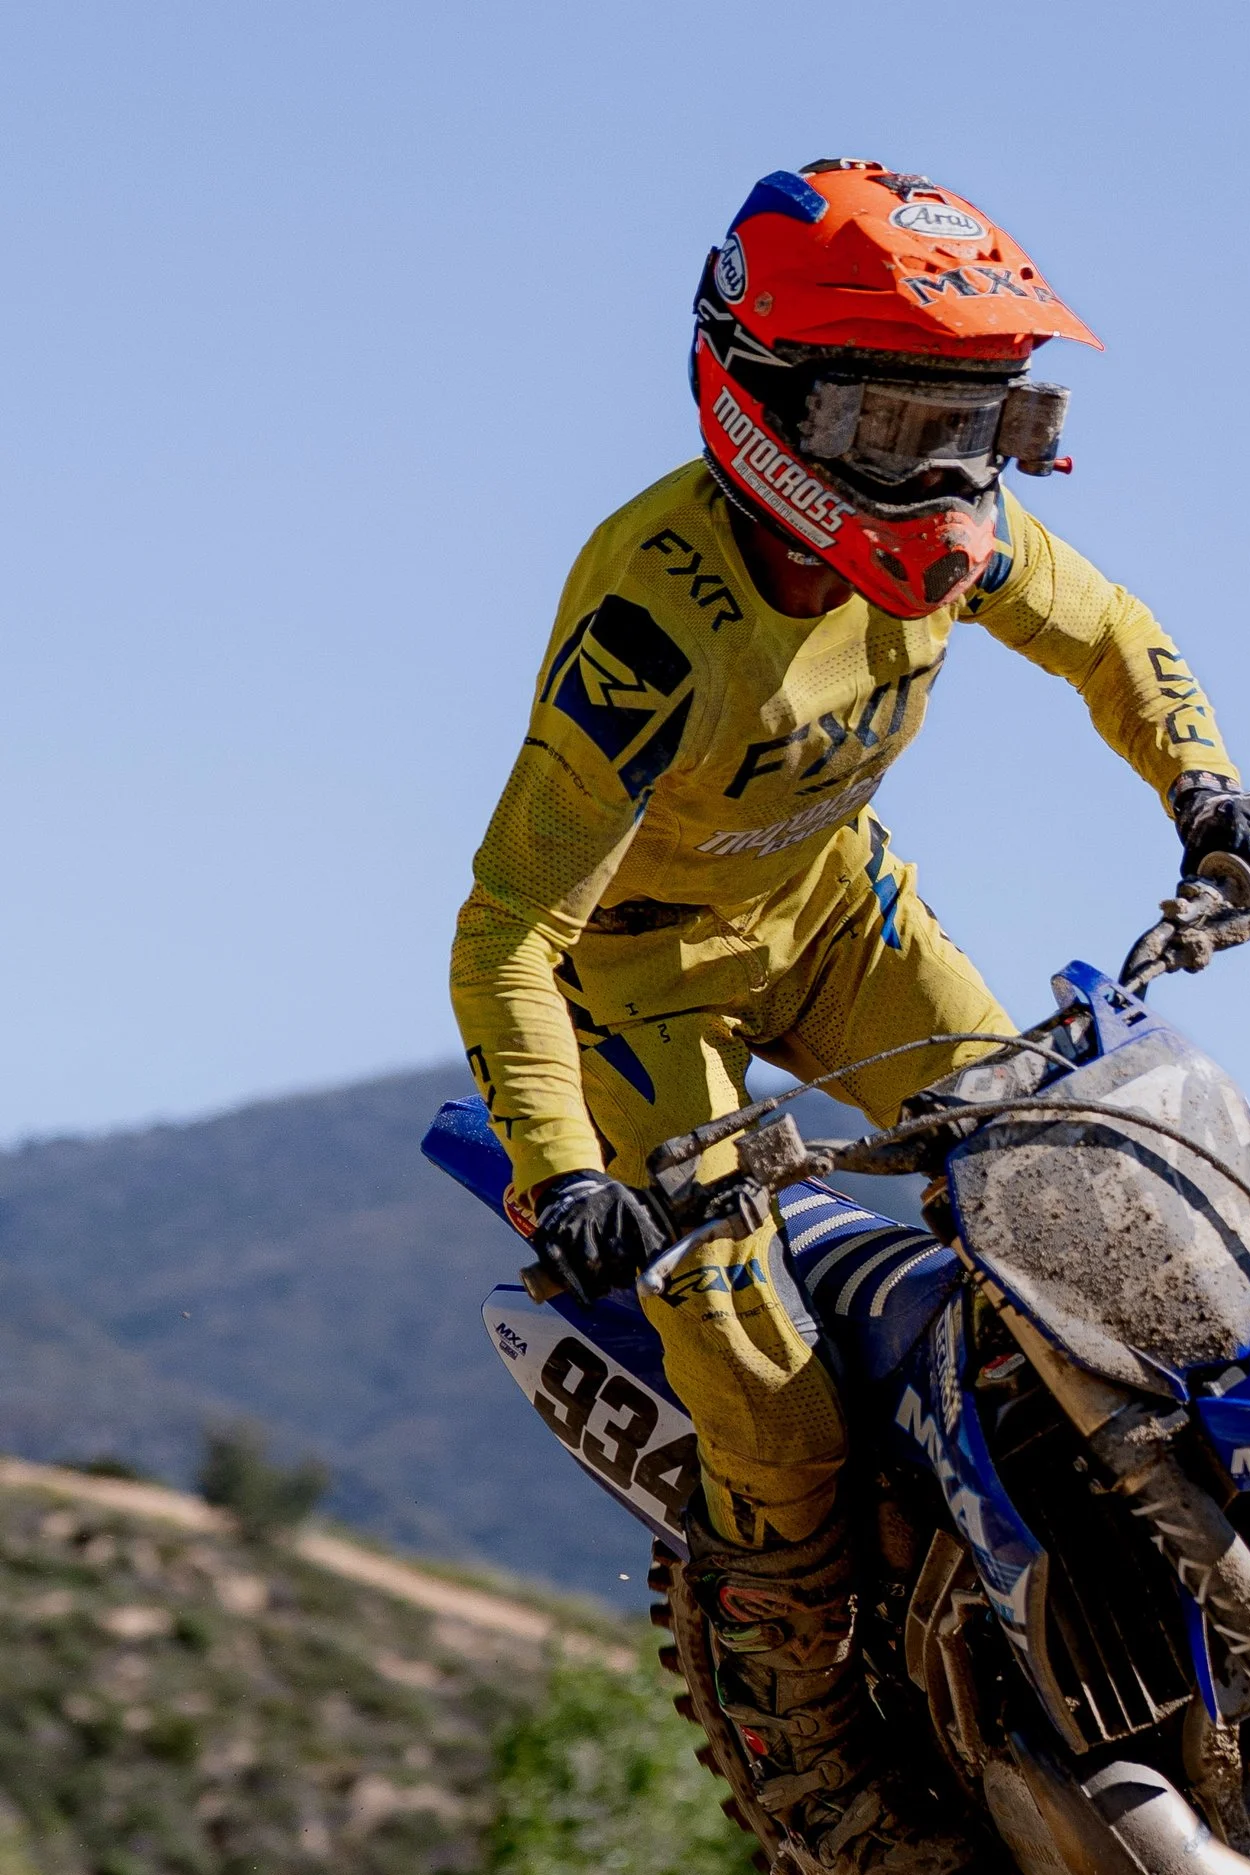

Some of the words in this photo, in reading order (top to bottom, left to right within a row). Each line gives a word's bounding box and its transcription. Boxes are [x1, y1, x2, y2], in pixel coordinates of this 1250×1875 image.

[903, 207, 974, 230] Arai
[721, 245, 744, 291] Arai
[712, 385, 857, 533] MOTOCROSS
[736, 460, 793, 520] ACTION
[640, 528, 744, 632] FXR
[496, 1322, 529, 1356] MXA
[533, 1336, 699, 1535] 934
